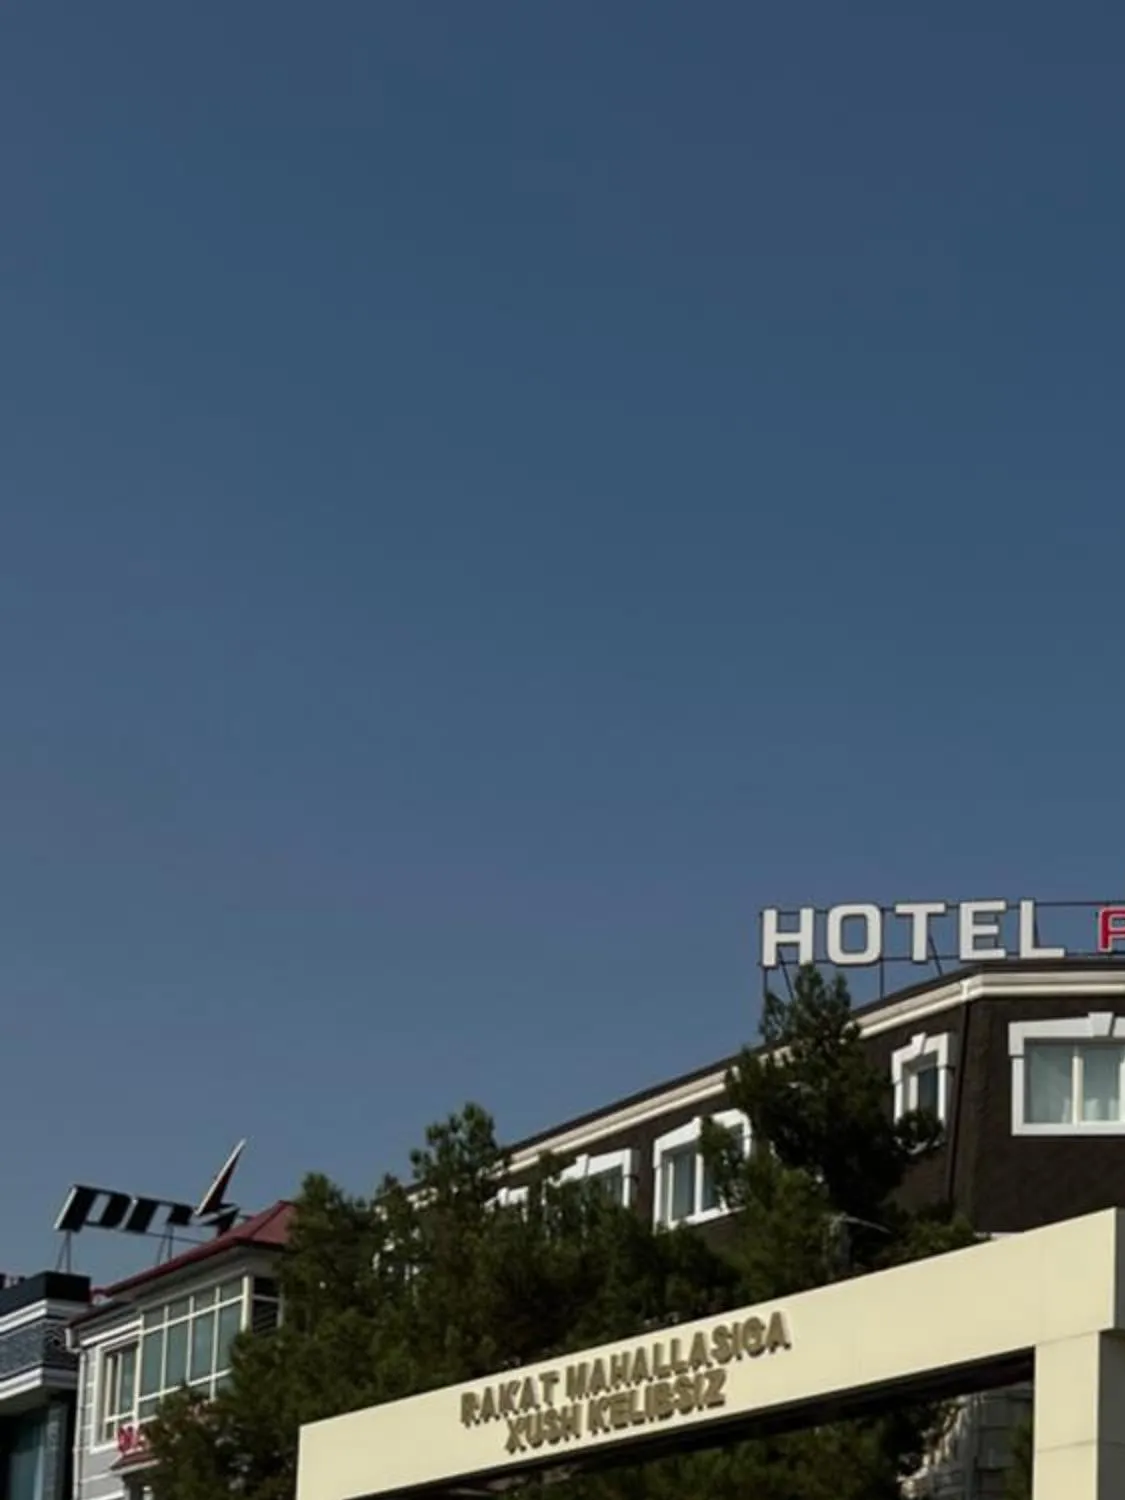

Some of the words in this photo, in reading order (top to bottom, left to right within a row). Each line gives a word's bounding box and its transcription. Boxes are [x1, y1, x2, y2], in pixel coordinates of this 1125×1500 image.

[761, 901, 1065, 967] HOTEL
[460, 1370, 560, 1429] RAKAT
[504, 1403, 582, 1455] XUSH
[587, 1368, 728, 1436] KELIBSIZ
